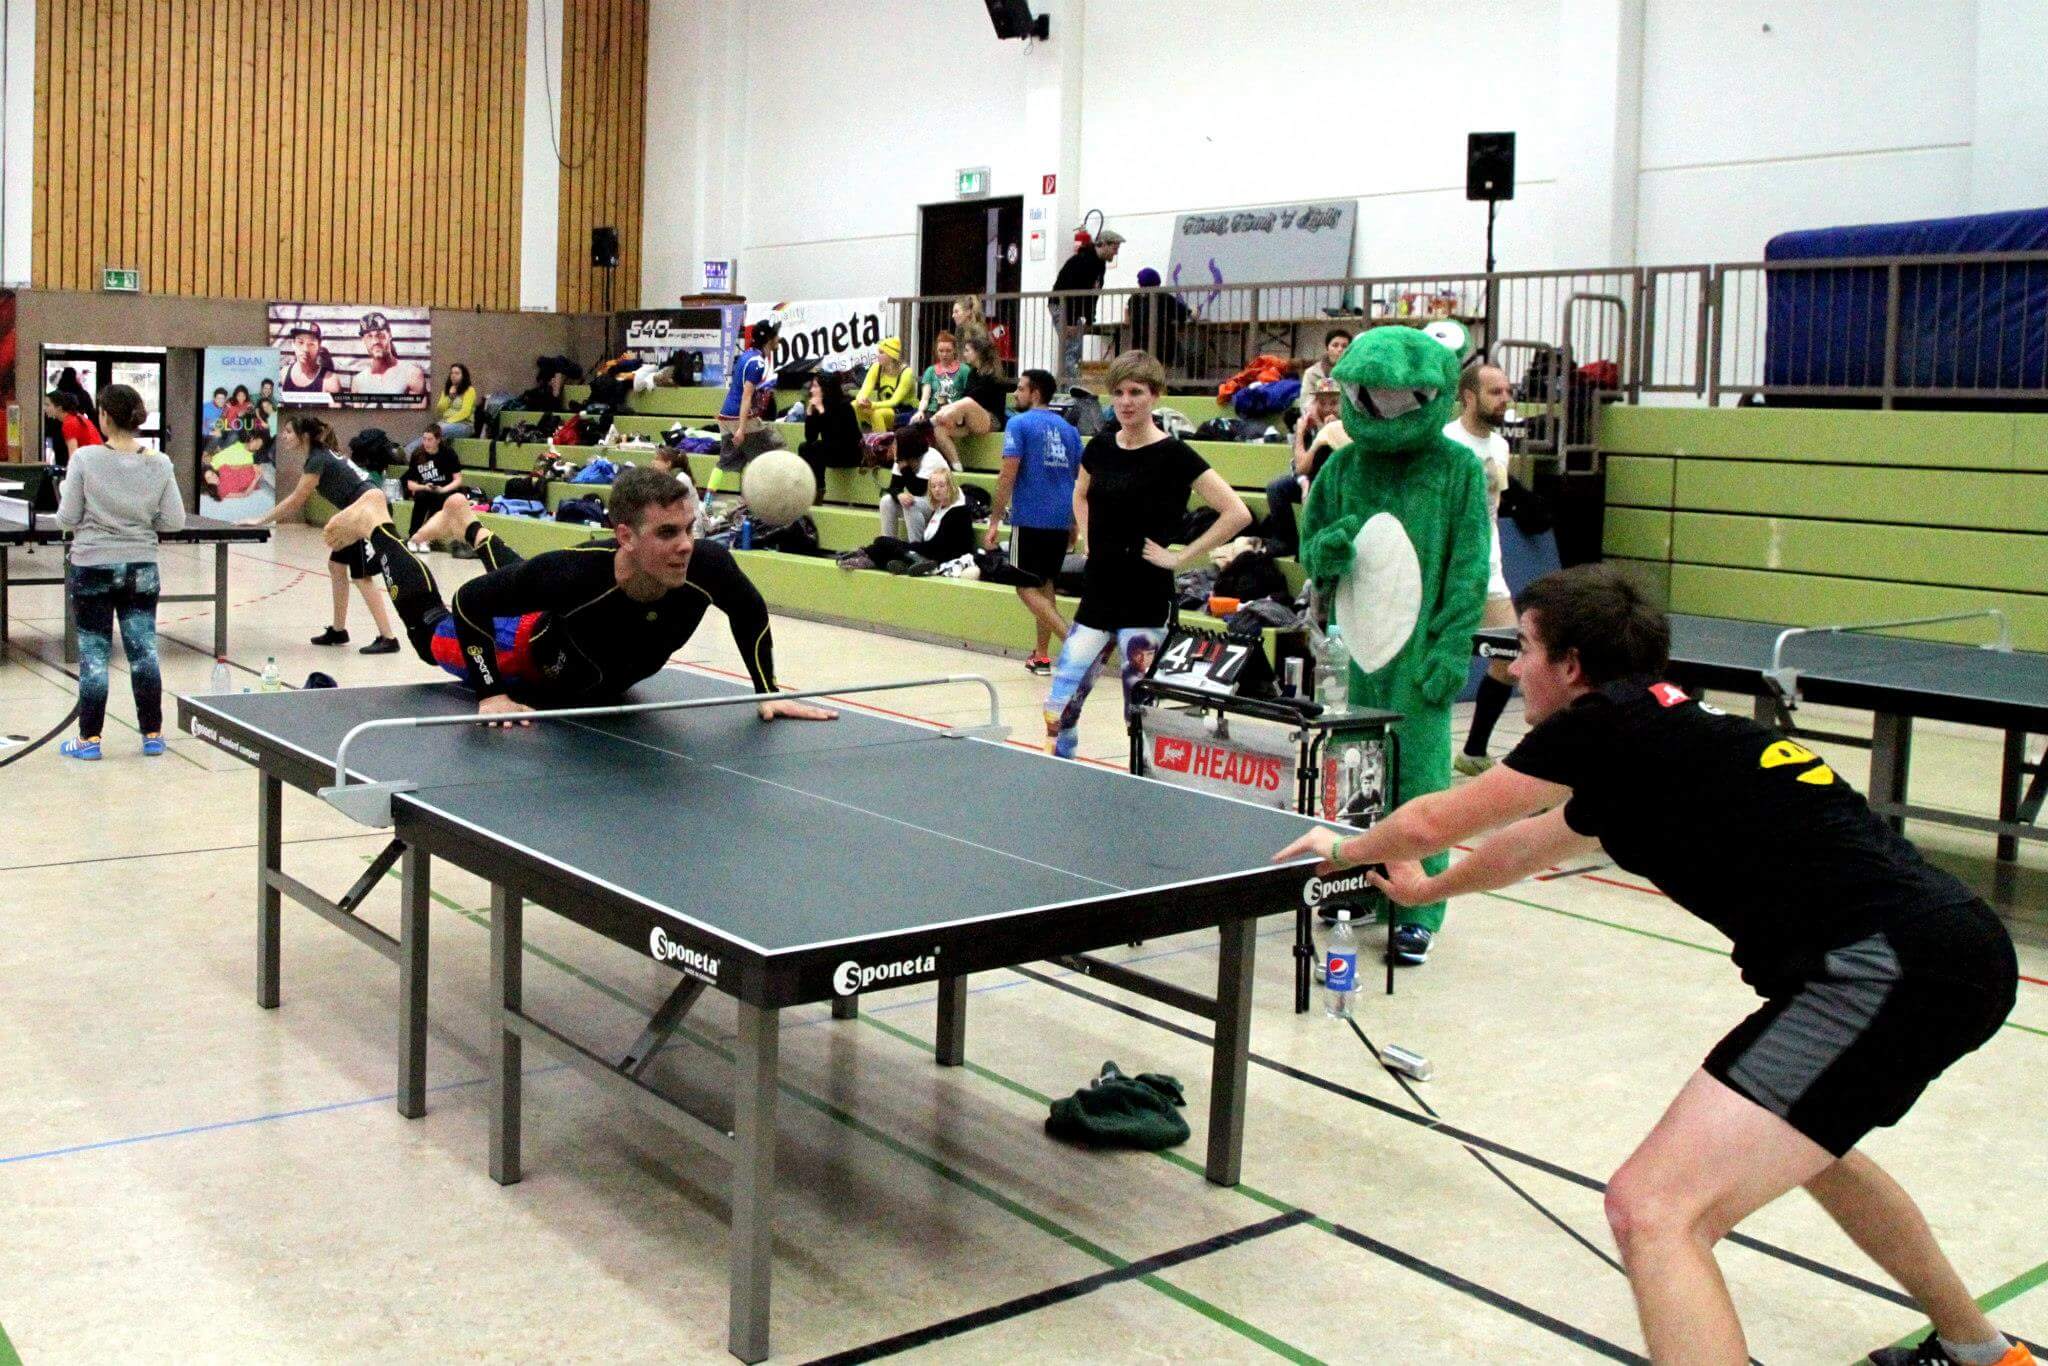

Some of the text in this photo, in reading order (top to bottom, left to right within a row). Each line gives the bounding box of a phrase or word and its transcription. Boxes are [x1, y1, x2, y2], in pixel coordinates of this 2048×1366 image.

[630, 320, 670, 338] 540
[772, 312, 880, 369] poneta
[1165, 638, 1193, 670] 4
[1216, 645, 1248, 677] 7
[1193, 744, 1281, 791] HEADIS
[650, 926, 718, 976] Sponeta
[833, 955, 936, 996] Sponeta
